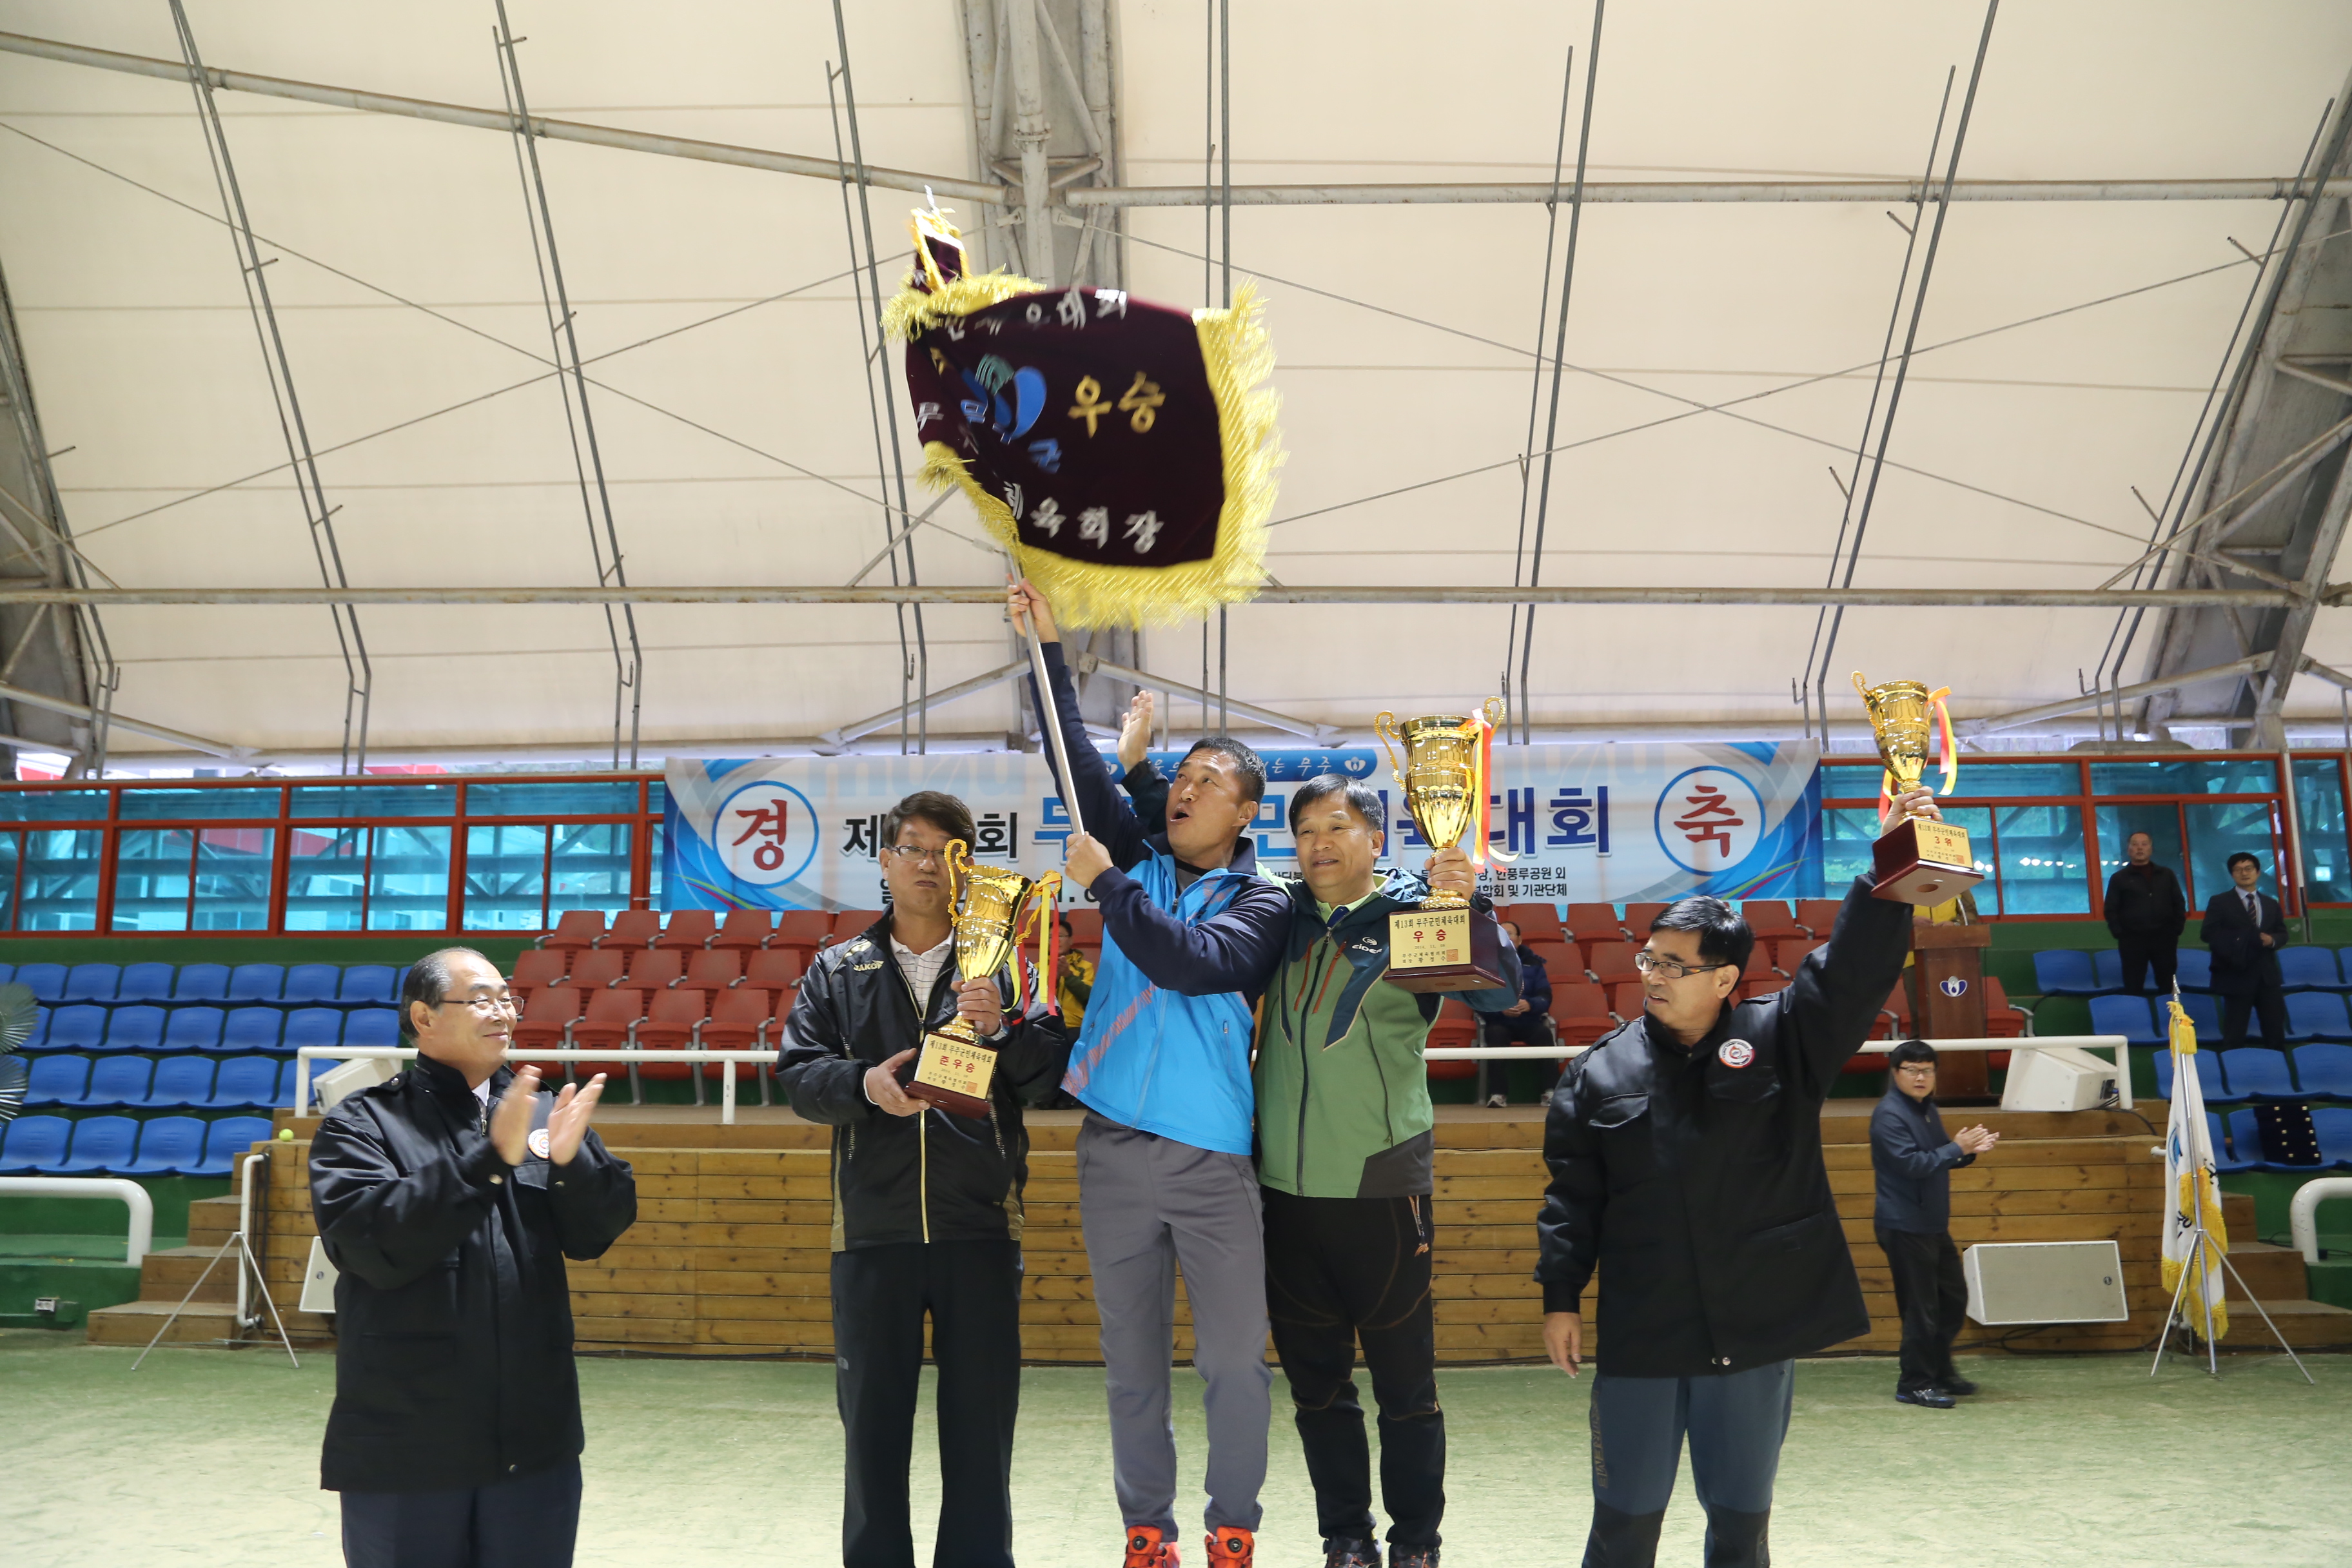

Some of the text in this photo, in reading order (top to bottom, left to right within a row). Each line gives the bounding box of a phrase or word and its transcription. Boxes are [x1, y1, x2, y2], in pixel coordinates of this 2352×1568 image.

[1673, 785, 1743, 858] 축
[731, 799, 787, 870] 경
[1555, 867, 1566, 880] 외
[1507, 884, 1518, 897] 및
[1522, 883, 1567, 897] 기관단체
[1395, 914, 1465, 929] 제13회 무주군민체육대회
[939, 1055, 975, 1073] 준우승
